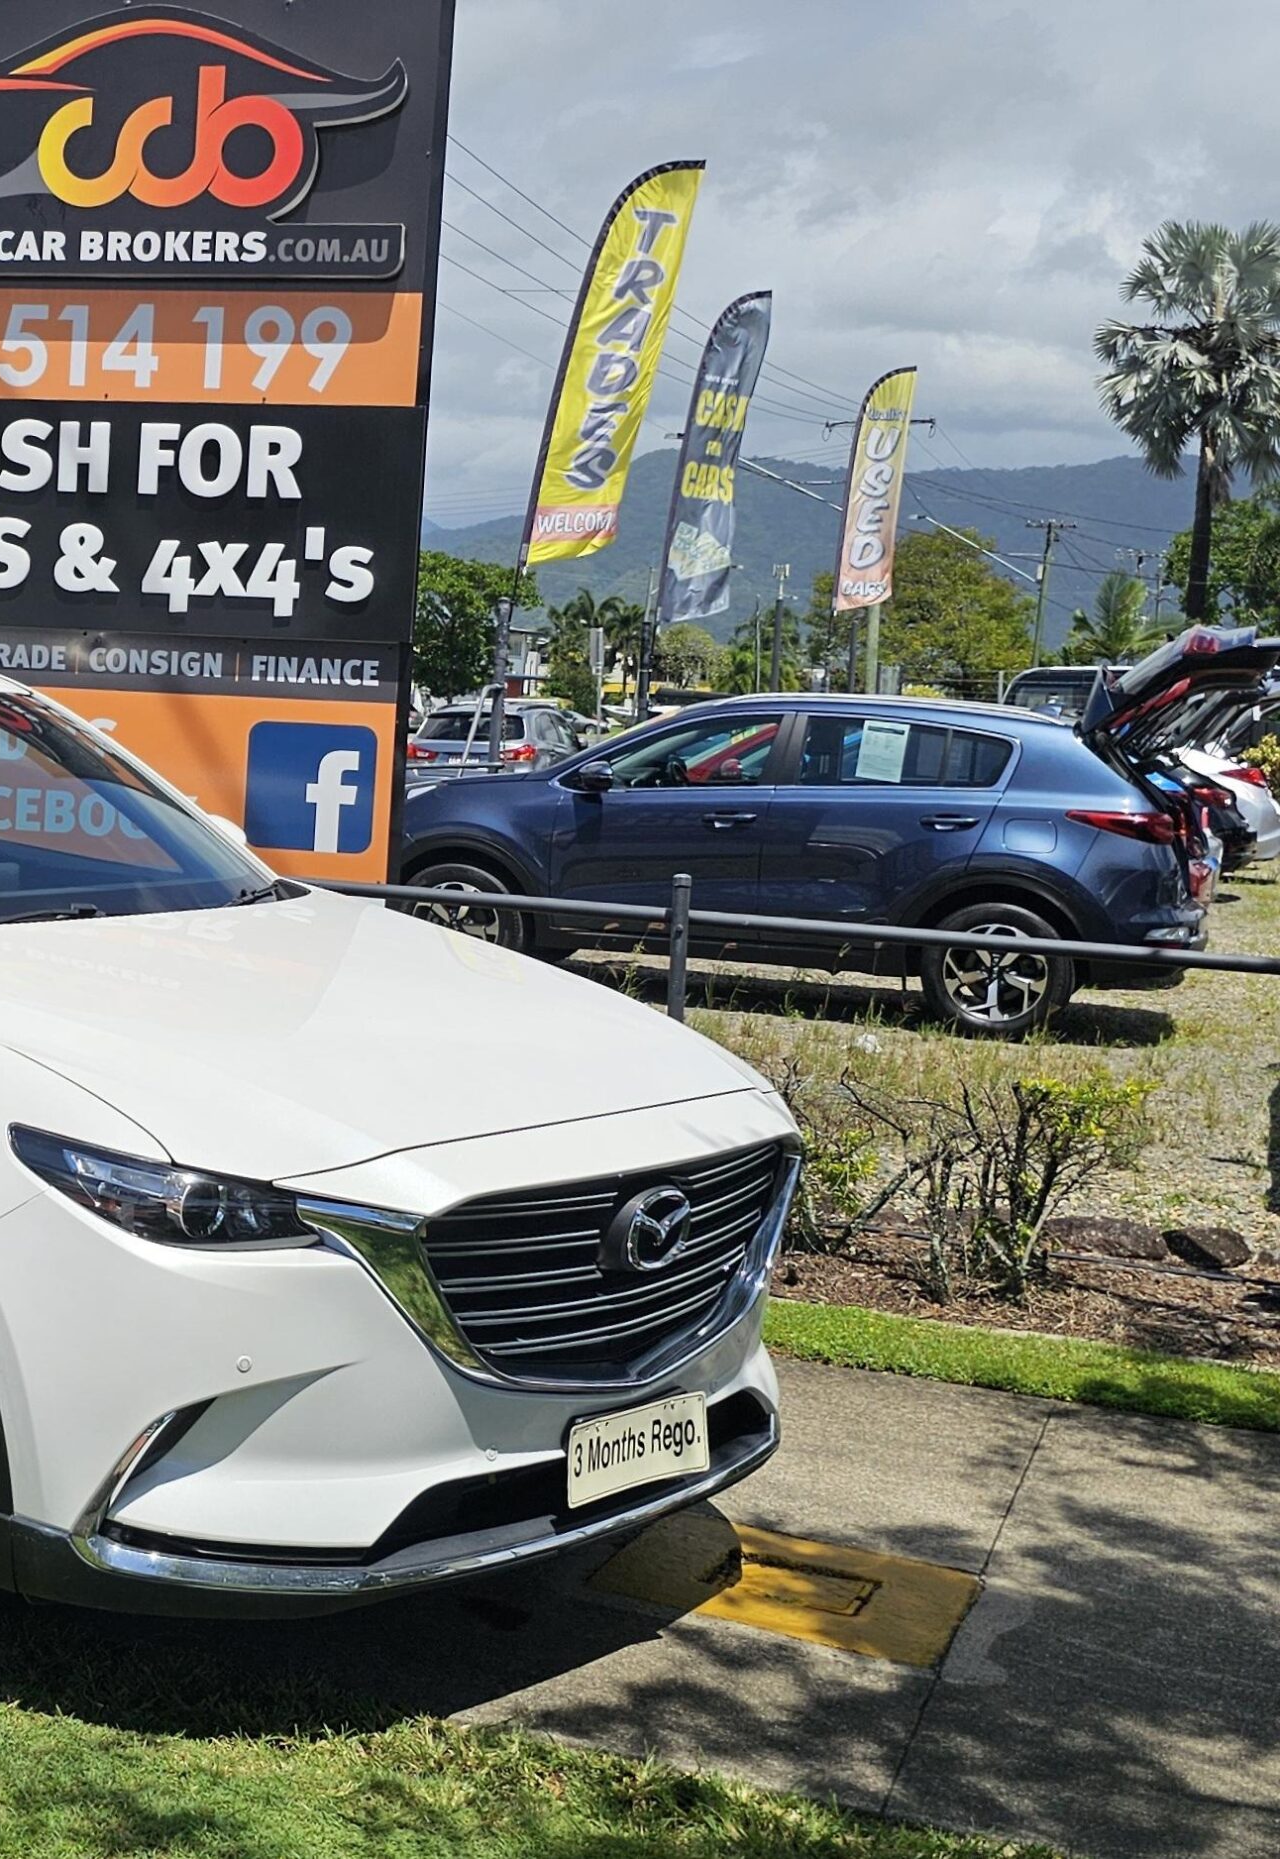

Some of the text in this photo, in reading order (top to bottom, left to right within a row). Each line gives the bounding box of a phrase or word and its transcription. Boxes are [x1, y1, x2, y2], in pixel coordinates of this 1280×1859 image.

[191, 306, 353, 394] 199
[565, 209, 677, 489] TRADES
[137, 421, 304, 499] FOR
[681, 461, 735, 506] CARS
[538, 511, 615, 533] WELCOM
[849, 426, 901, 570] USED
[53, 522, 120, 594] &
[88, 647, 223, 680] CONSIGN
[252, 654, 380, 687] FINANCE
[574, 1419, 702, 1478] 3 Months Rego.
